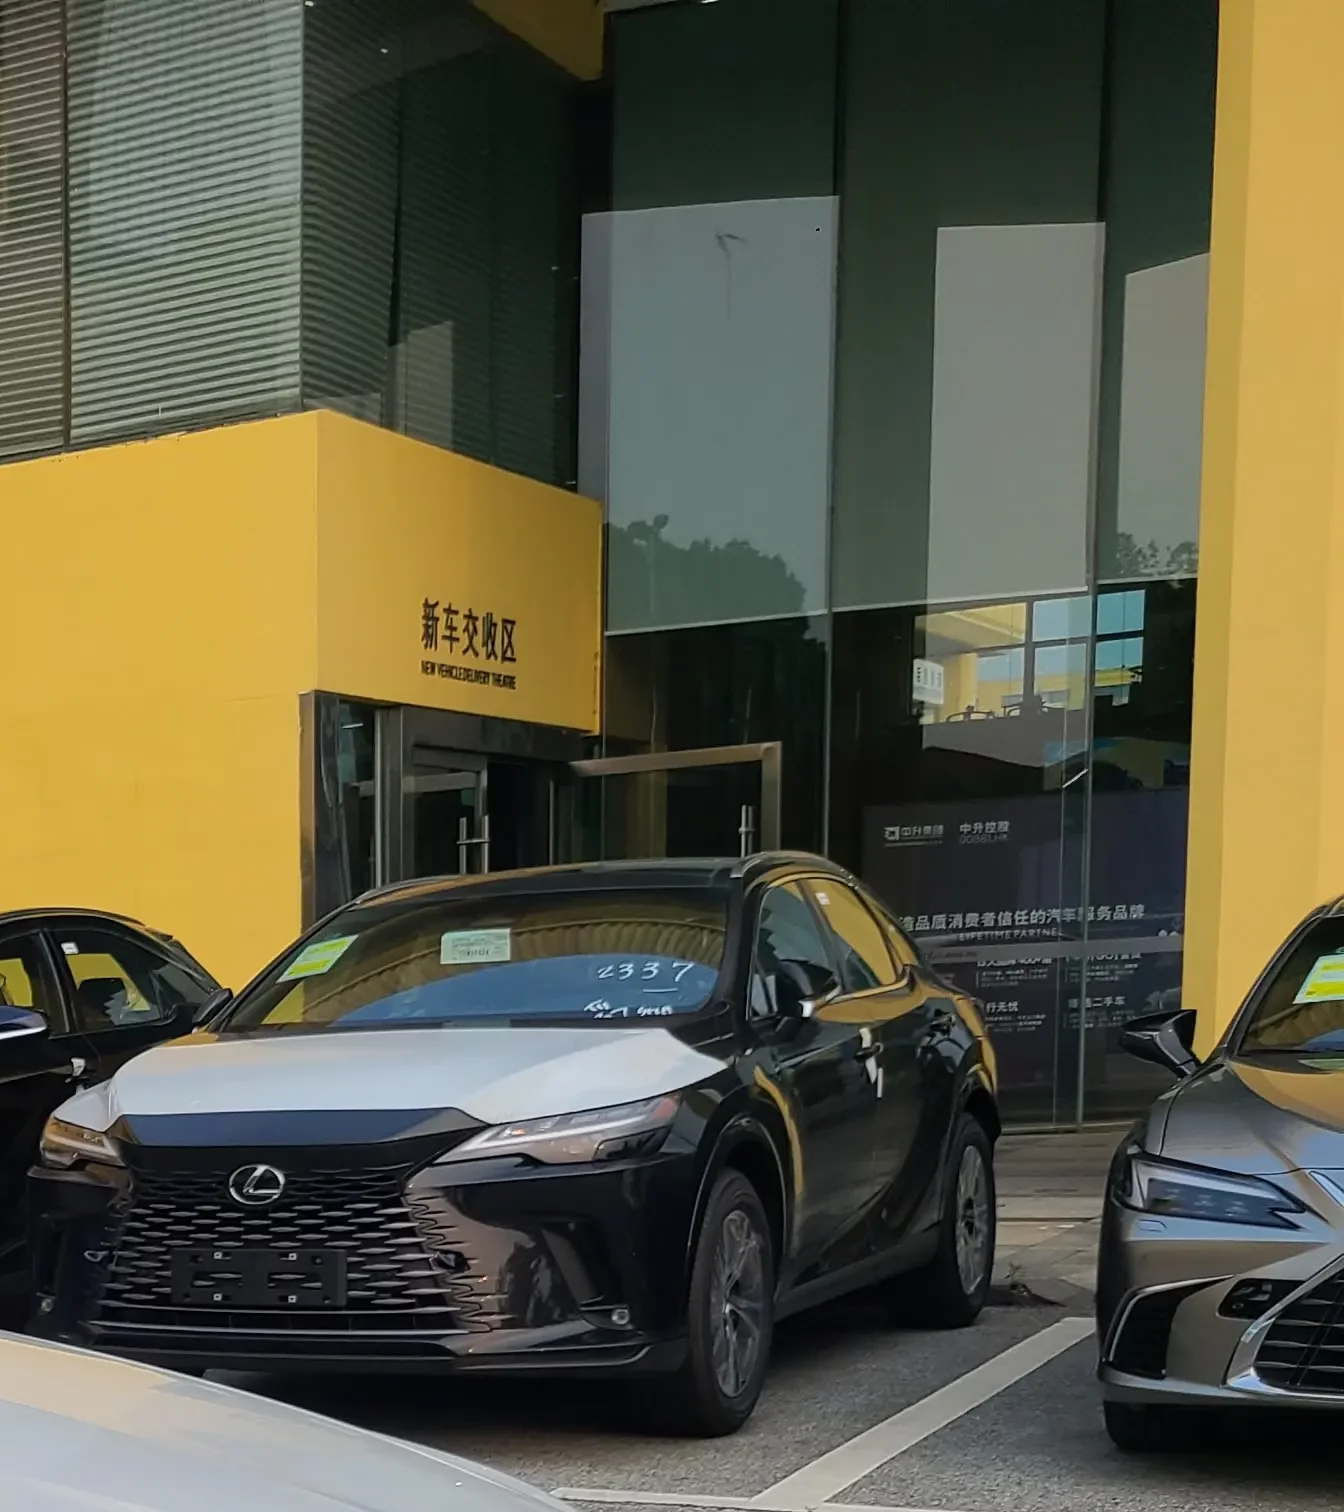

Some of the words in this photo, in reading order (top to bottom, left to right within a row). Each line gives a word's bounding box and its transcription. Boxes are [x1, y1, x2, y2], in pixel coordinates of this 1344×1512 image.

[421, 597, 517, 664] 新车交收区
[421, 660, 436, 676] NEW
[597, 961, 695, 982] 2337
